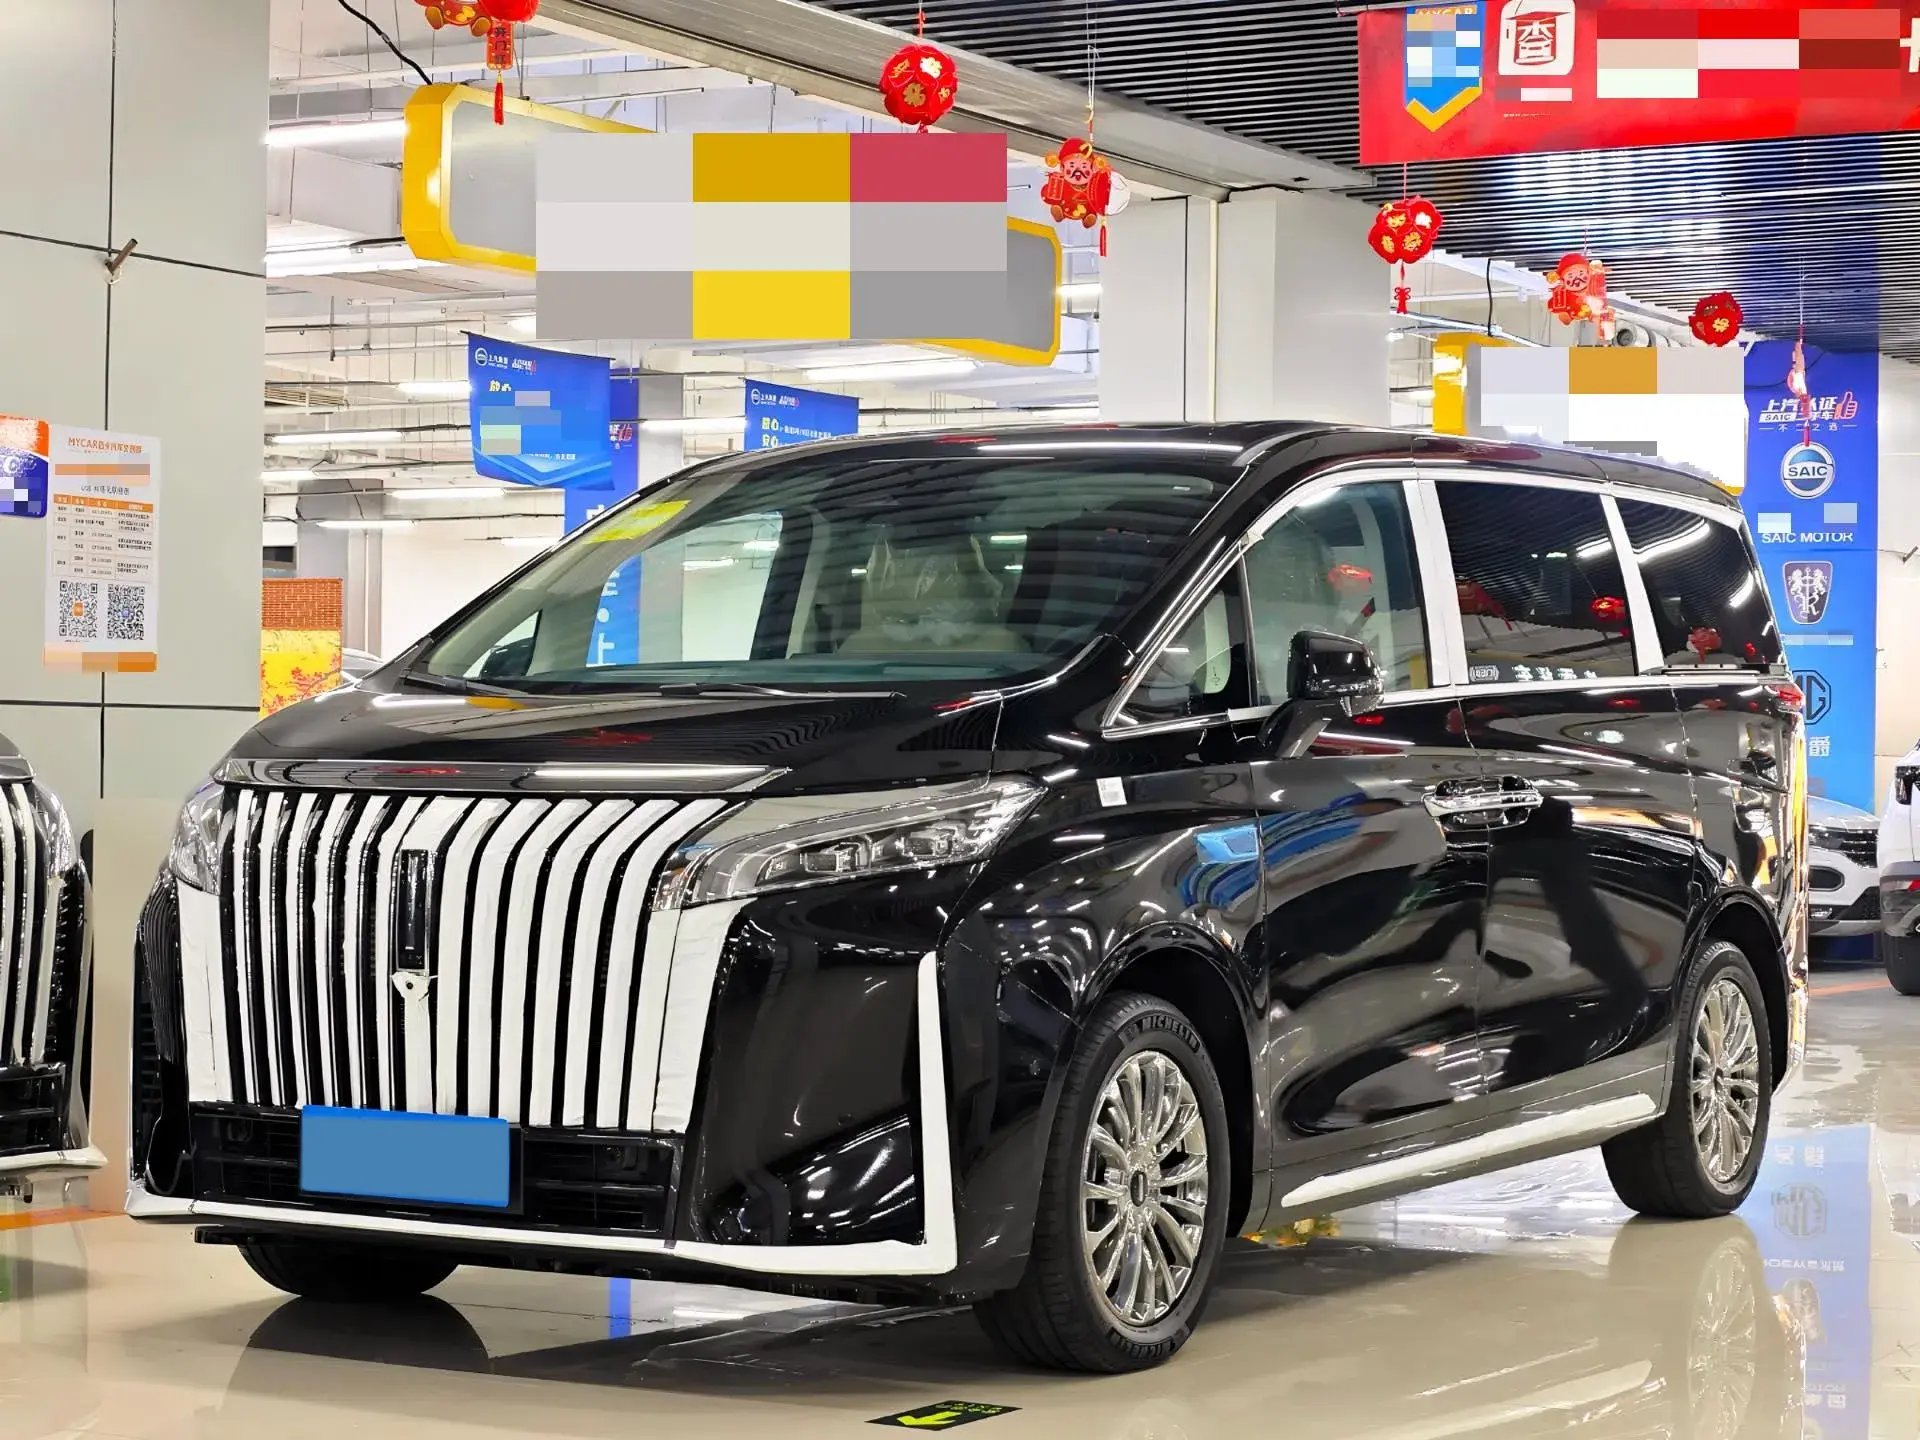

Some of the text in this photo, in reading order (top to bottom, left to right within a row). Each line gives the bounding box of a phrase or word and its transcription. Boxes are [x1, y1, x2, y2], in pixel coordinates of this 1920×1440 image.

[1788, 466, 1827, 477] SAIC
[1762, 532, 1854, 544] SAIC MOTOR
[1142, 1015, 1200, 1053] MICHELIN
